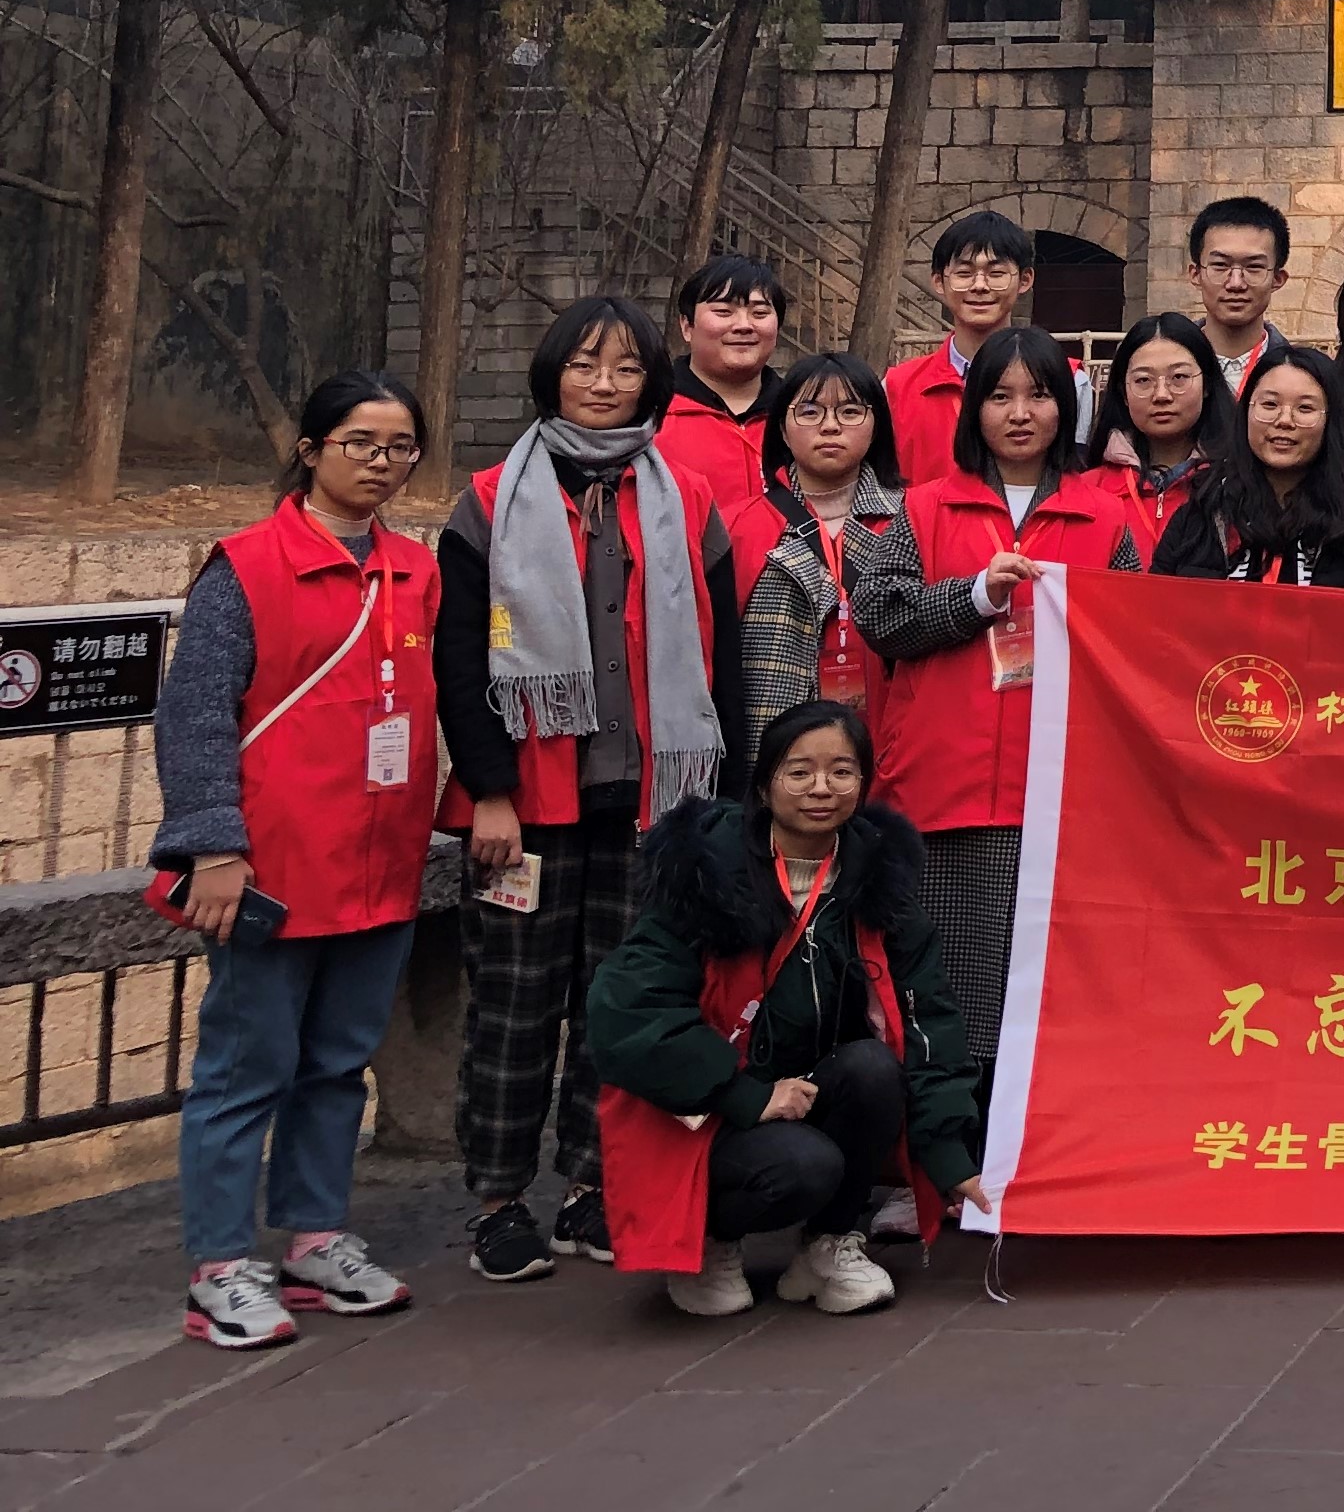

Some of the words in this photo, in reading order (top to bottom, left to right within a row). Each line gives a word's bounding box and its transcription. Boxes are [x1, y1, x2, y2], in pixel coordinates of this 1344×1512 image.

[52, 633, 148, 663] 请勿翻越
[1222, 727, 1275, 740] 1960-1969
